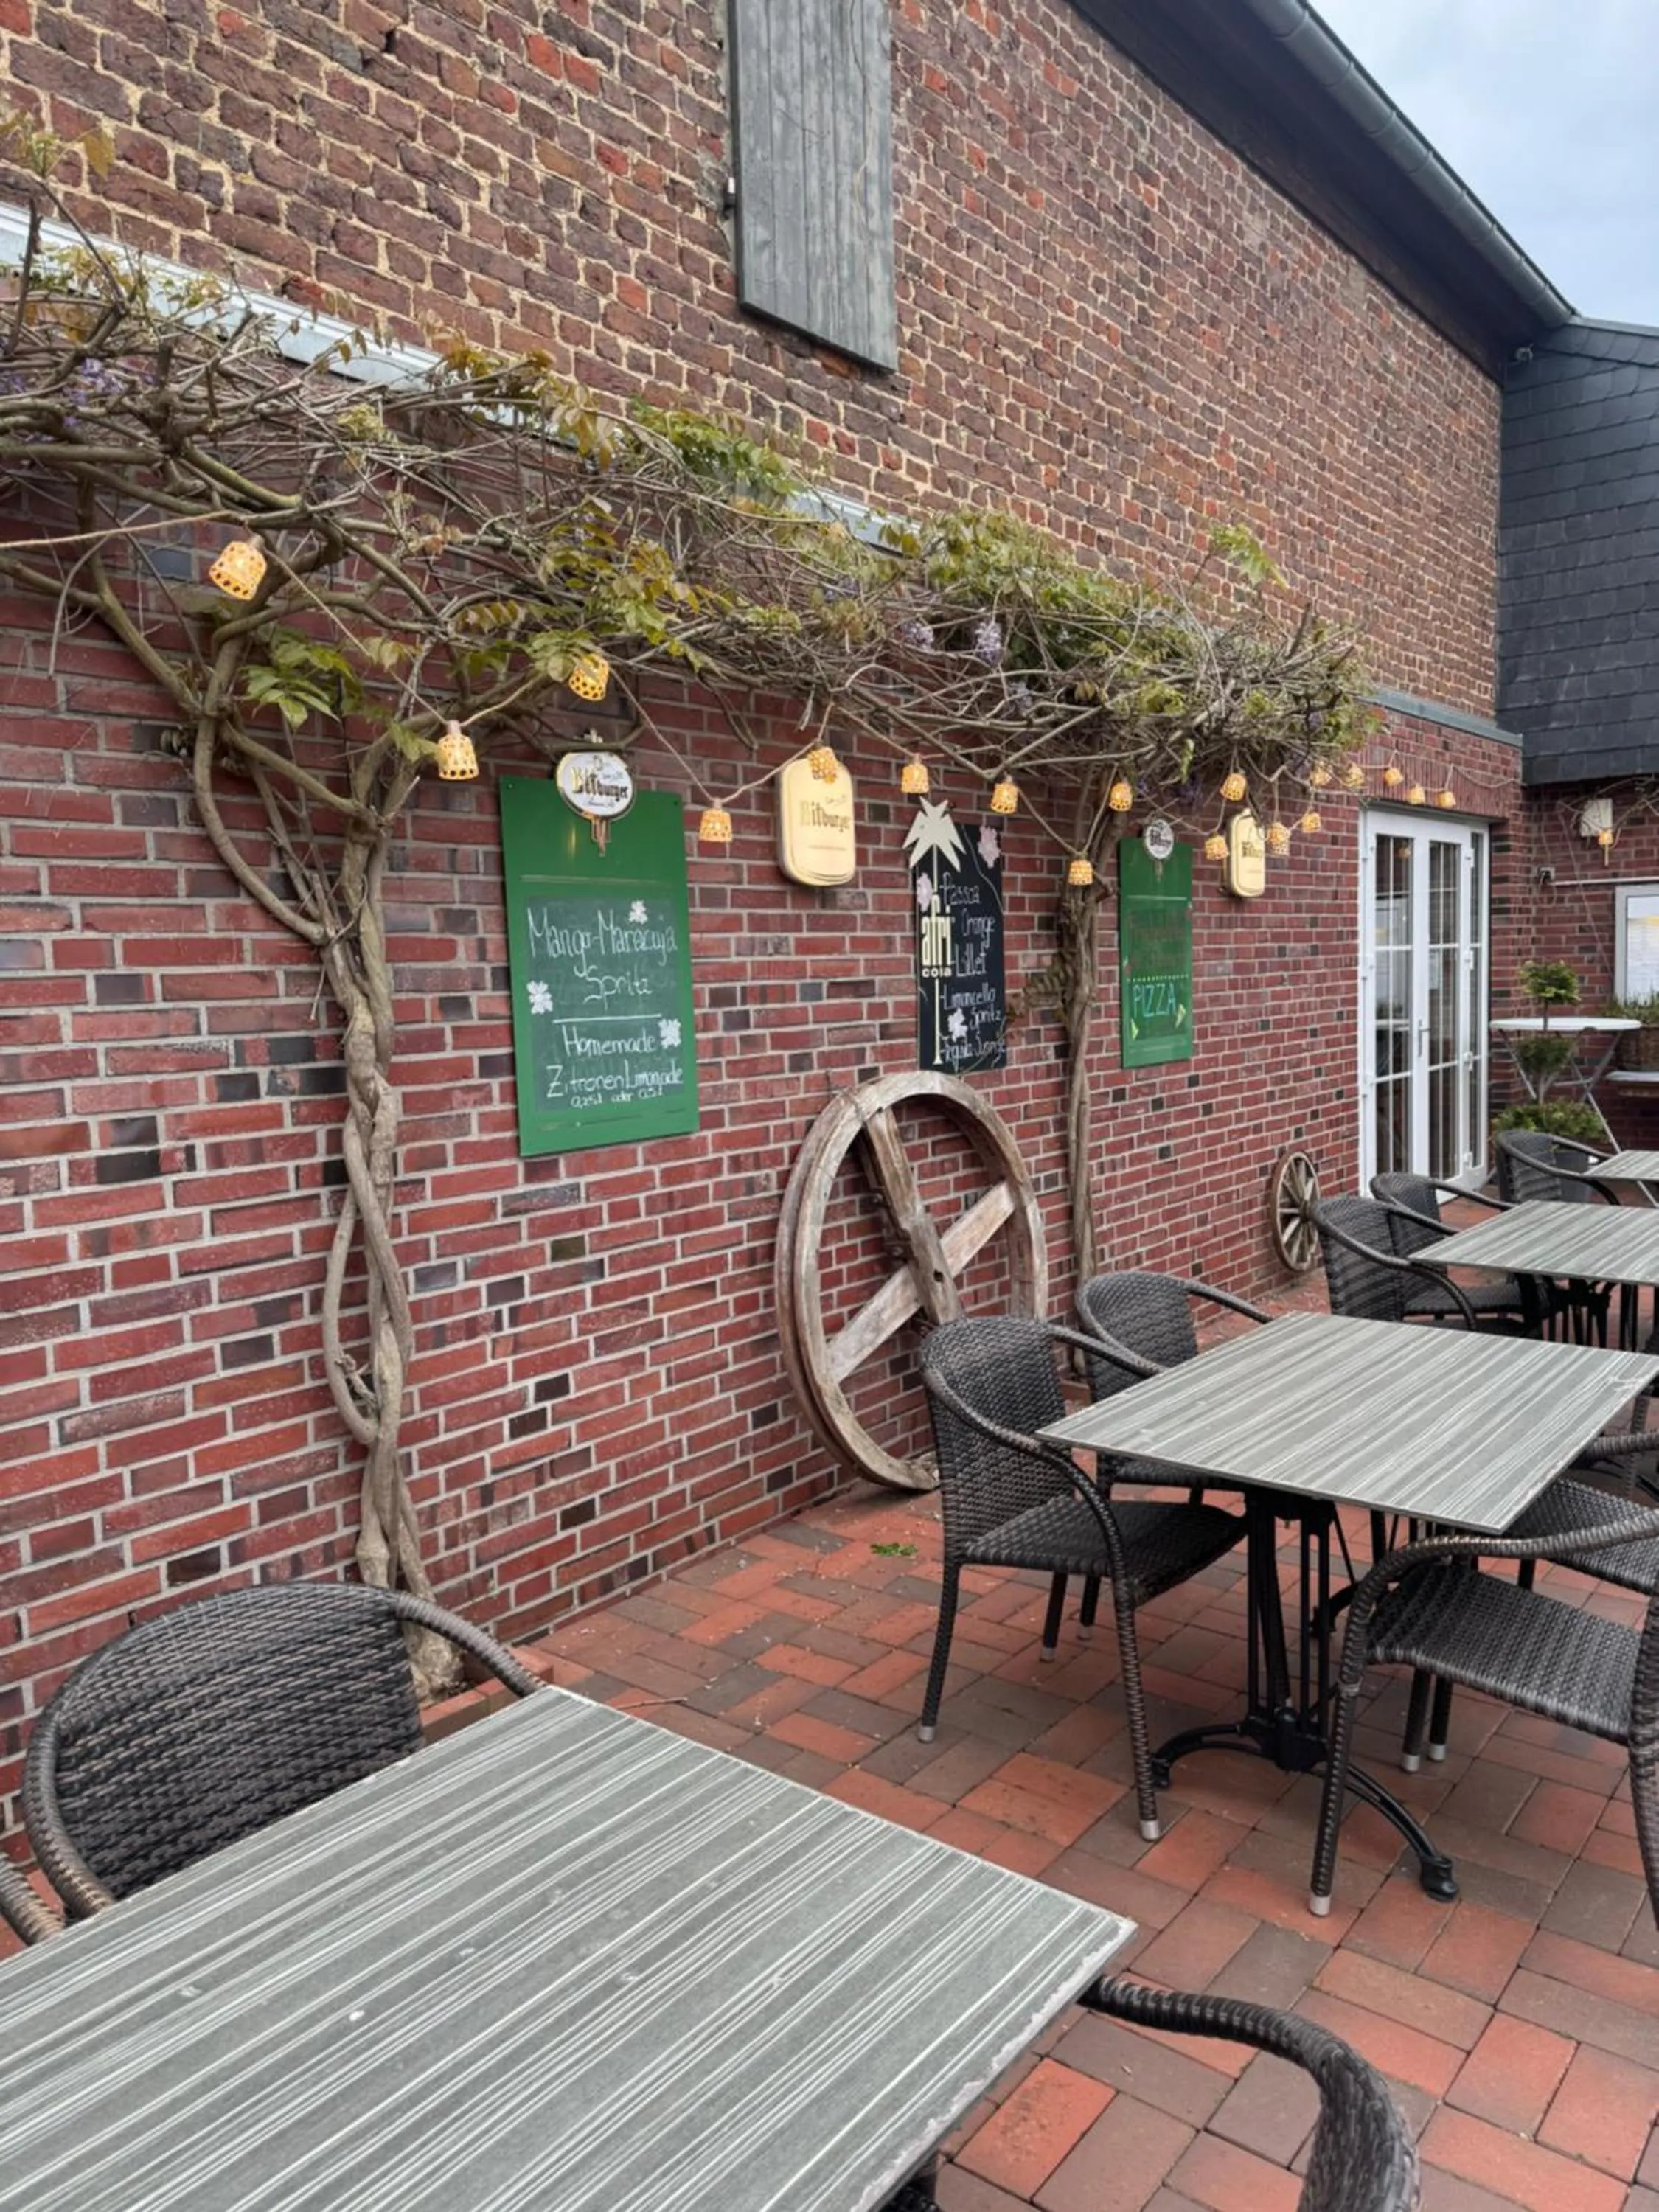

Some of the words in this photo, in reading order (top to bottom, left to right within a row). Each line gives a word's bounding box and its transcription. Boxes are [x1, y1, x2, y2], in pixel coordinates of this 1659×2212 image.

[922, 894, 951, 966] afri
[583, 964, 653, 1011] Spritz
[922, 967, 952, 978] cola
[1133, 982, 1177, 1018] PIZZA
[970, 1003, 1001, 1034] Spritz
[562, 1025, 658, 1057] Homemade
